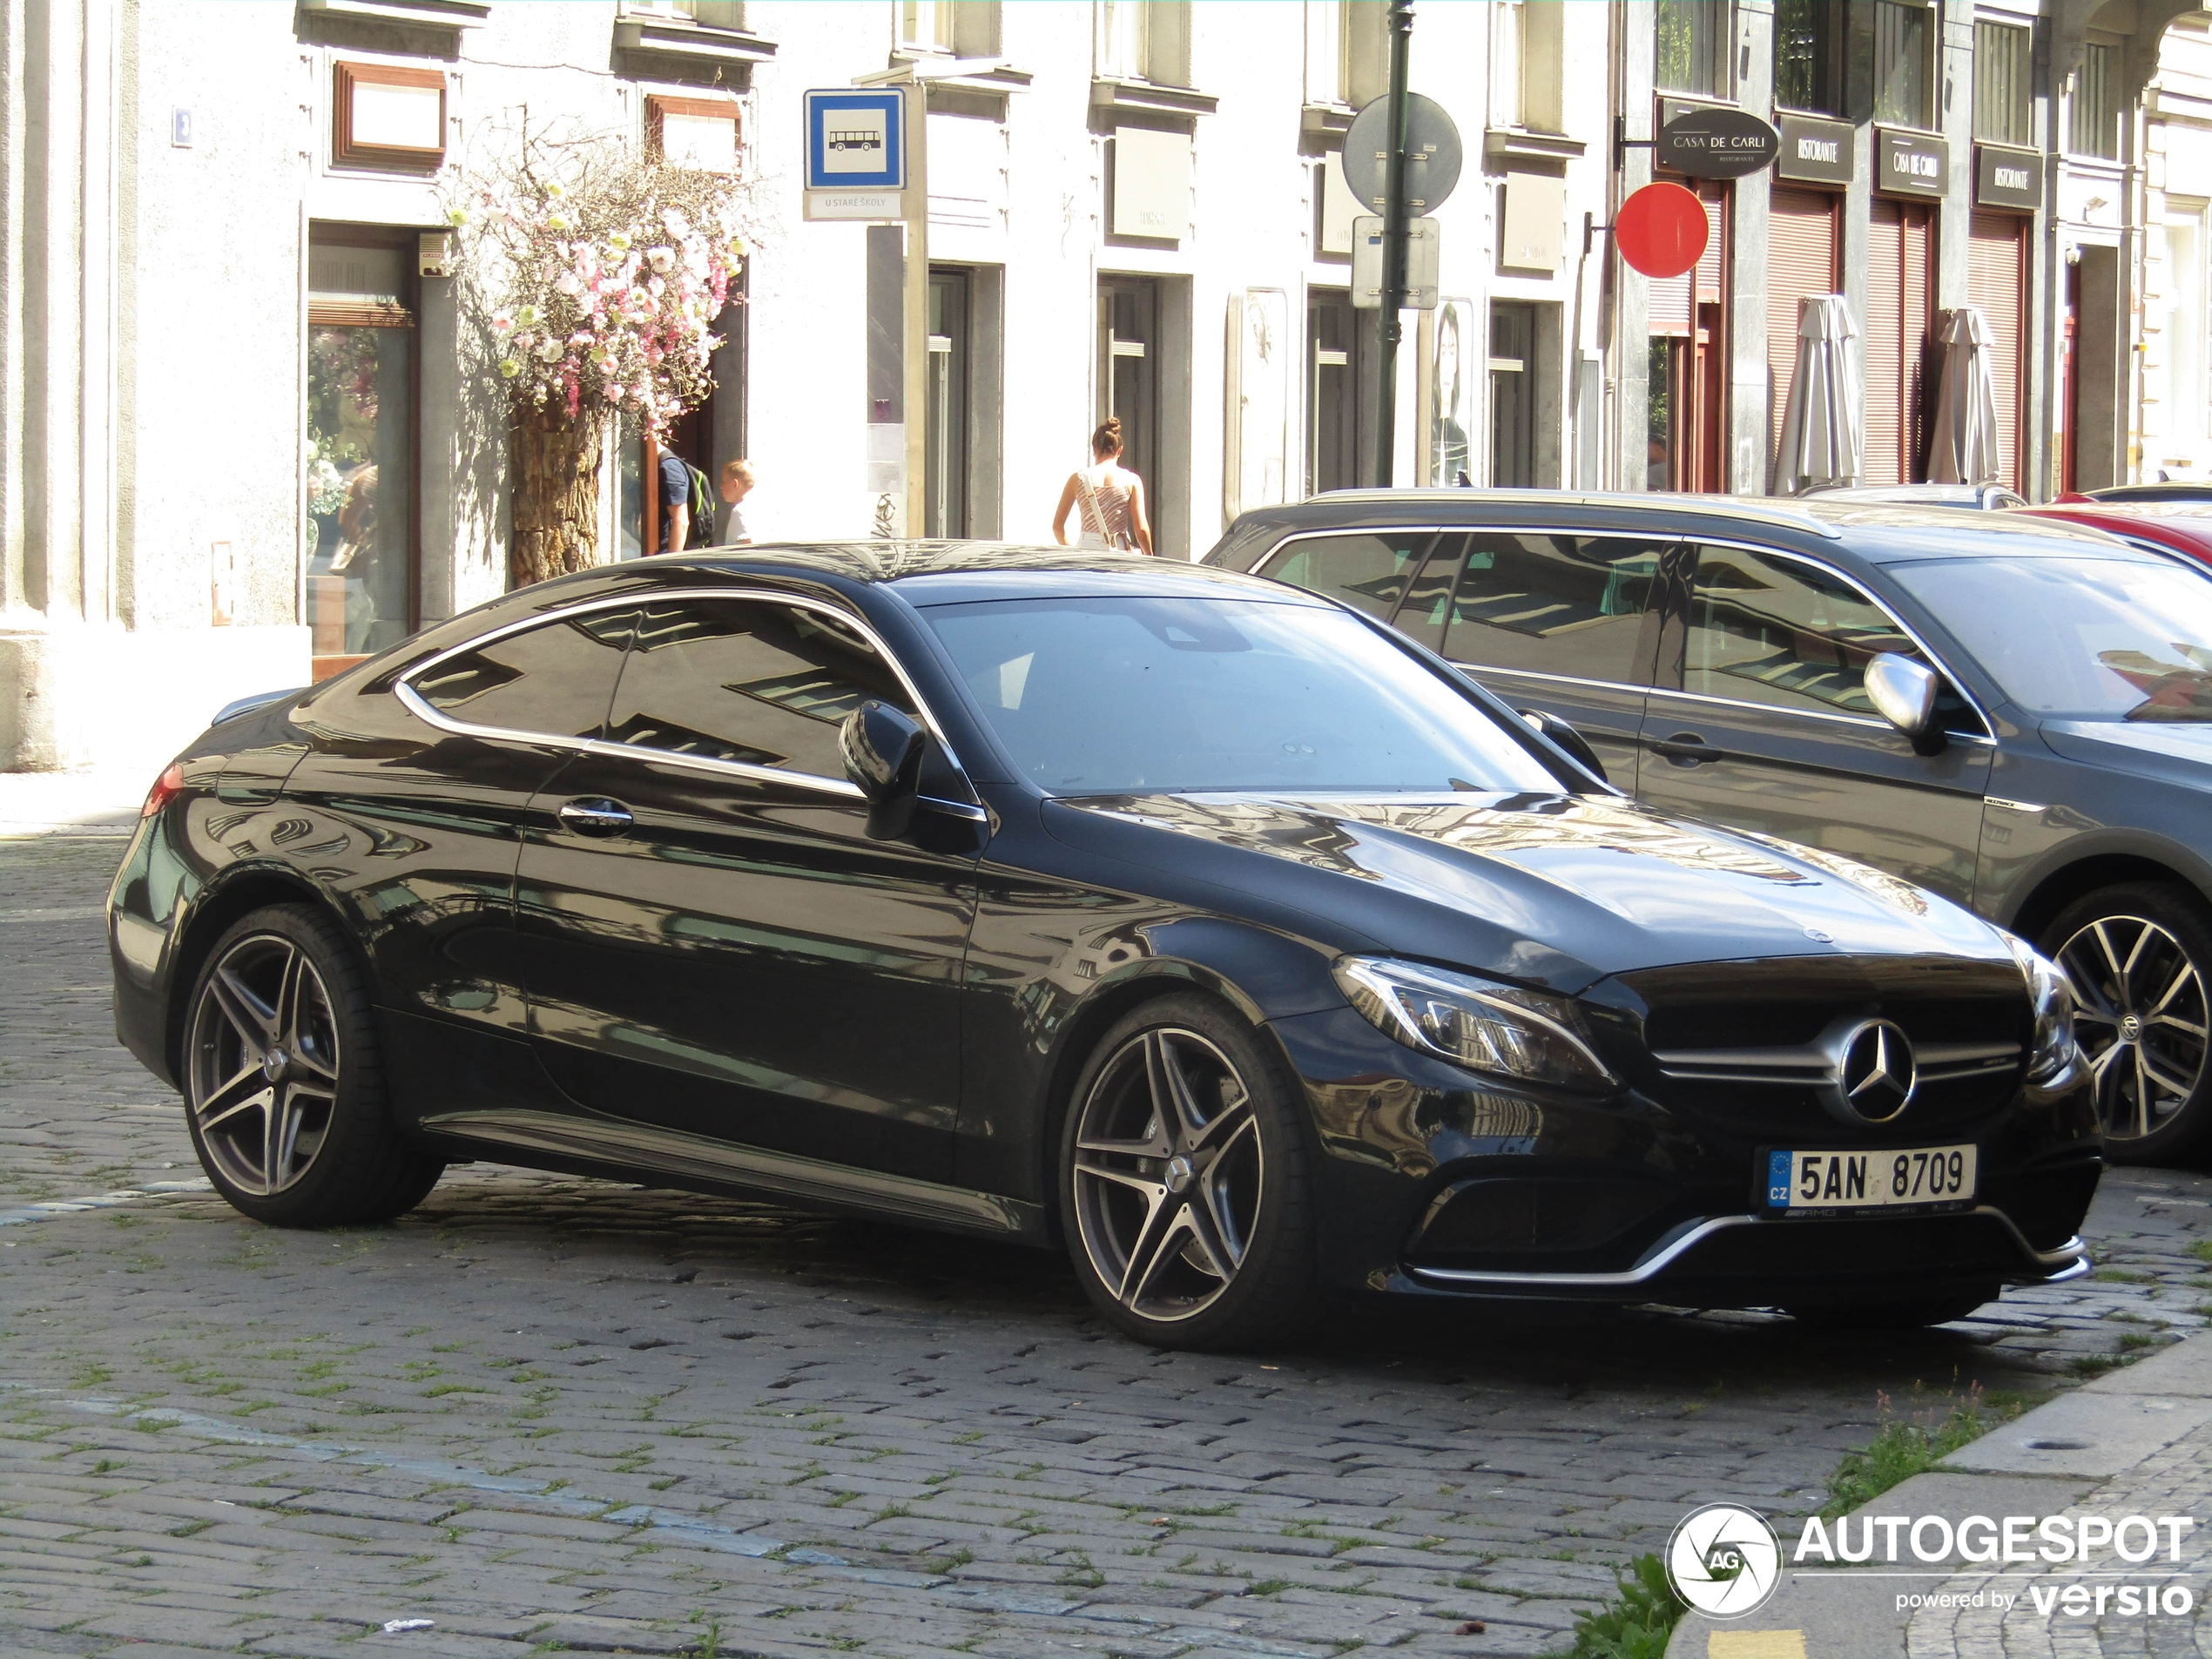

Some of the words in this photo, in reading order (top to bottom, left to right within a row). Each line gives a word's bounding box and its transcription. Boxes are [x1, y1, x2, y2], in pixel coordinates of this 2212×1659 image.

[181, 114, 191, 137] 3
[1673, 137, 1705, 148] CASA
[1710, 137, 1726, 148] DE
[1731, 137, 1764, 148] CARLI
[1797, 138, 1838, 163] RISTORANTE
[1893, 152, 1910, 173] CASA
[1910, 154, 1919, 175] DE
[1994, 167, 2029, 190] RISTORANTE
[833, 198, 859, 206] STARÉ
[860, 198, 887, 206] ŠKOLY
[1800, 1156, 1866, 1200] 5AN
[1892, 1150, 1963, 1197] 8709
[1770, 1187, 1787, 1200] CZ
